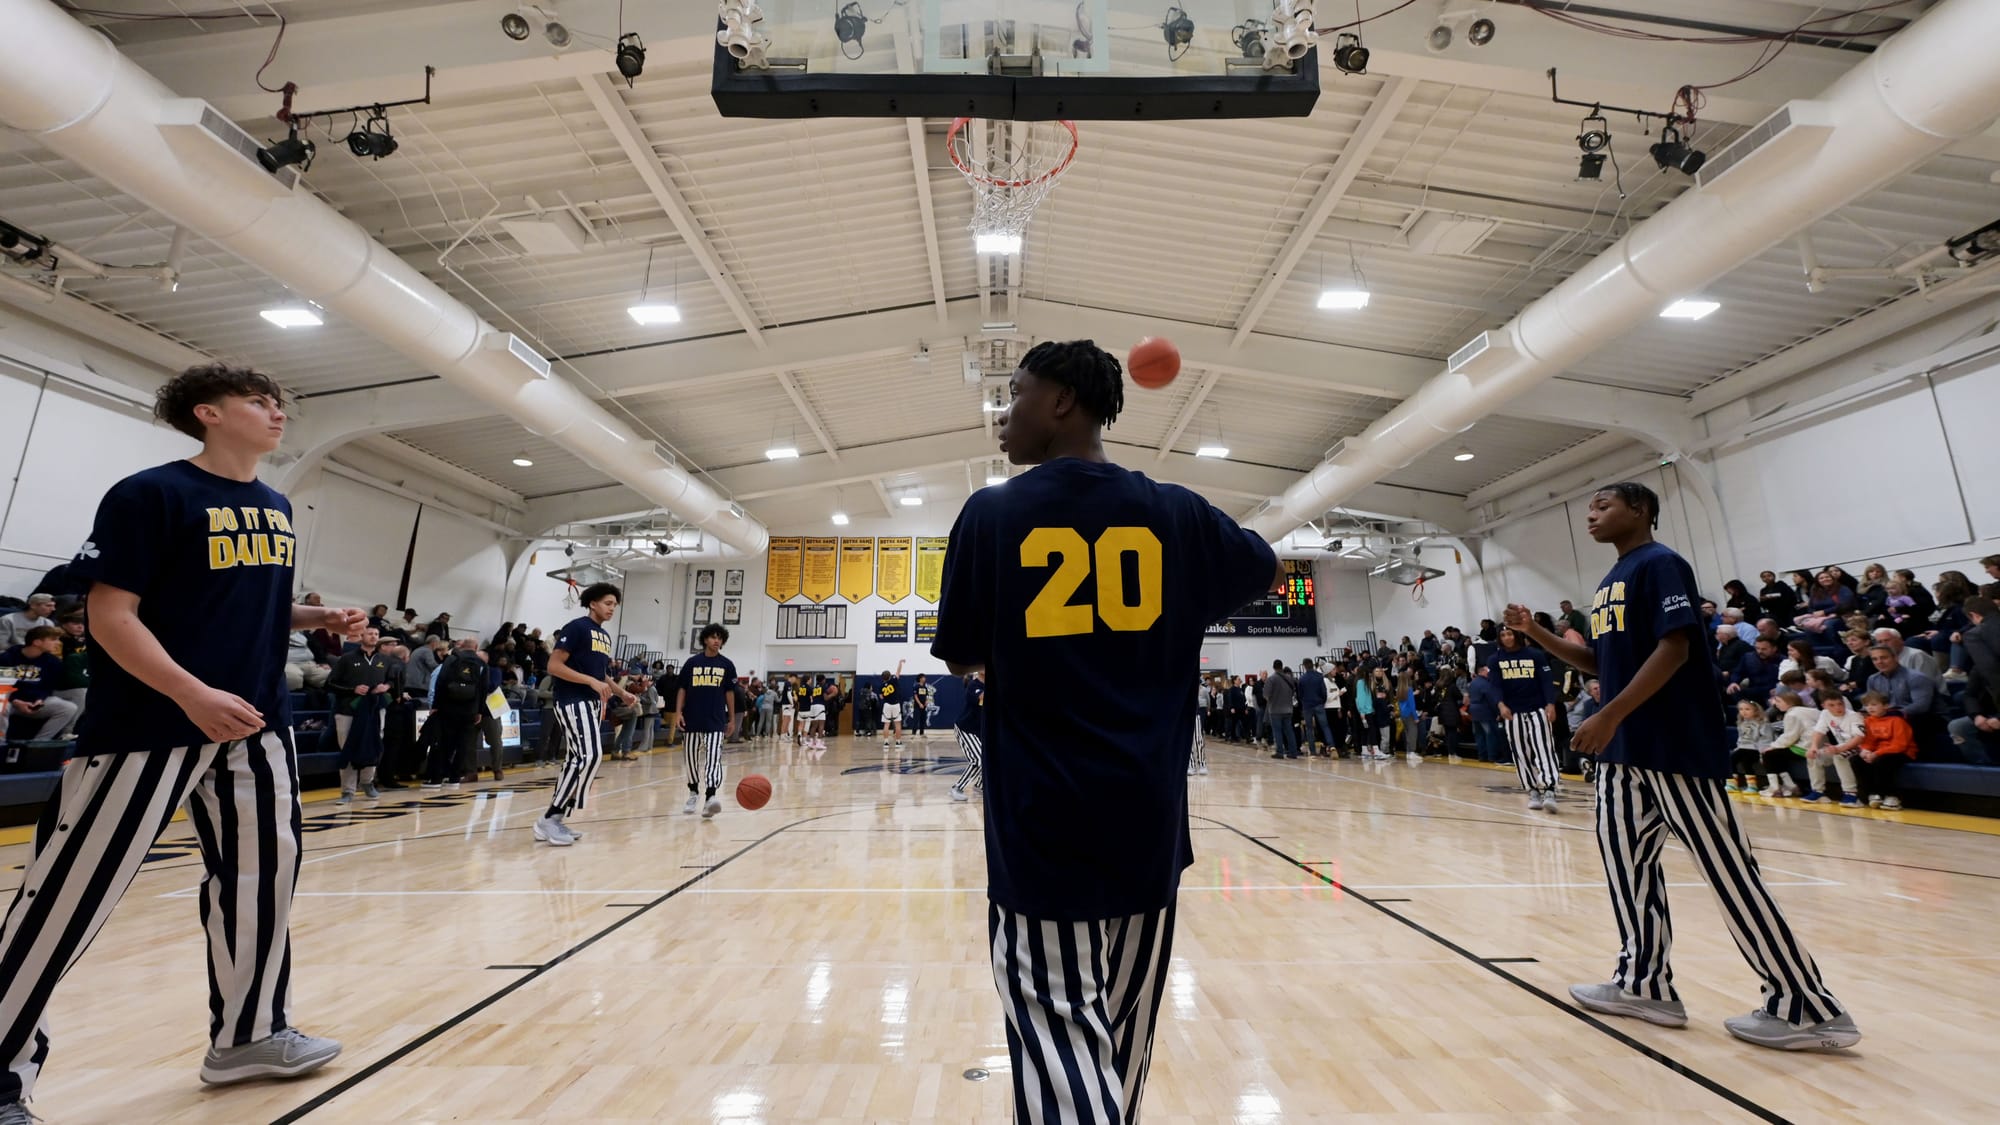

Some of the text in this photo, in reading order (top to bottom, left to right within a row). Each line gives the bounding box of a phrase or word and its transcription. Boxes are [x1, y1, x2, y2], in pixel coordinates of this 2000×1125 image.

[205, 507, 239, 532] DO
[240, 507, 260, 530] IT
[208, 533, 295, 570] DAILEY
[1020, 527, 1162, 638] 20
[1610, 581, 1626, 602] OR
[1247, 625, 1272, 634] Sports
[1499, 659, 1535, 669] DO IT FOR
[693, 667, 725, 676] DO IT FOR
[1502, 668, 1535, 679] DAILEY
[692, 675, 723, 688] DAILEY
[882, 684, 895, 697] 20
